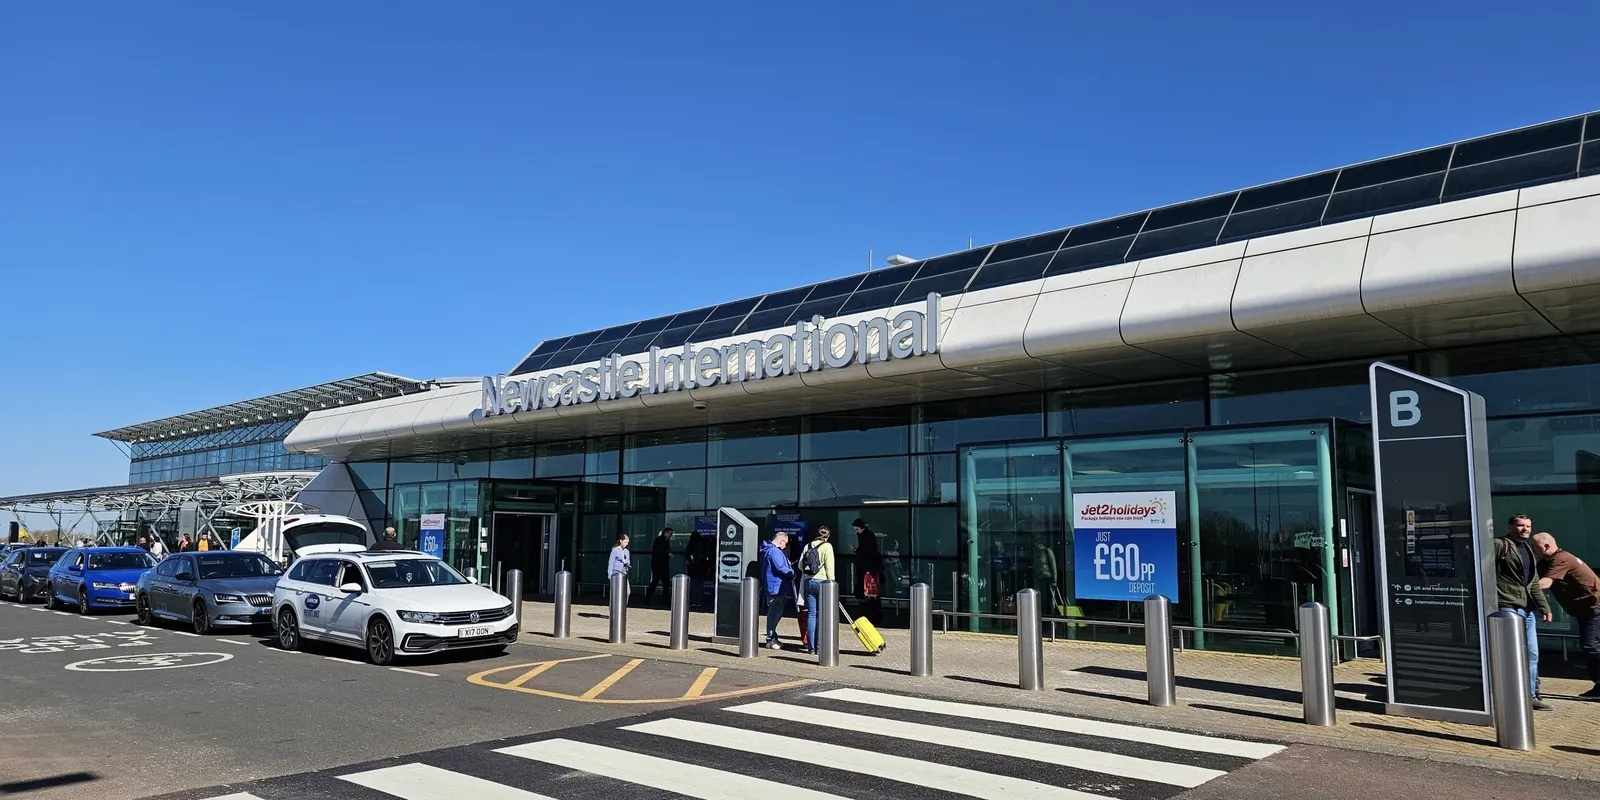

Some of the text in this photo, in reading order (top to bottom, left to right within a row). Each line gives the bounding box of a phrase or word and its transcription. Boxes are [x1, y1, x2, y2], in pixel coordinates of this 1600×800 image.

[481, 292, 941, 417] Newcastle International
[1389, 390, 1421, 427] B
[1096, 532, 1111, 542] JUST
